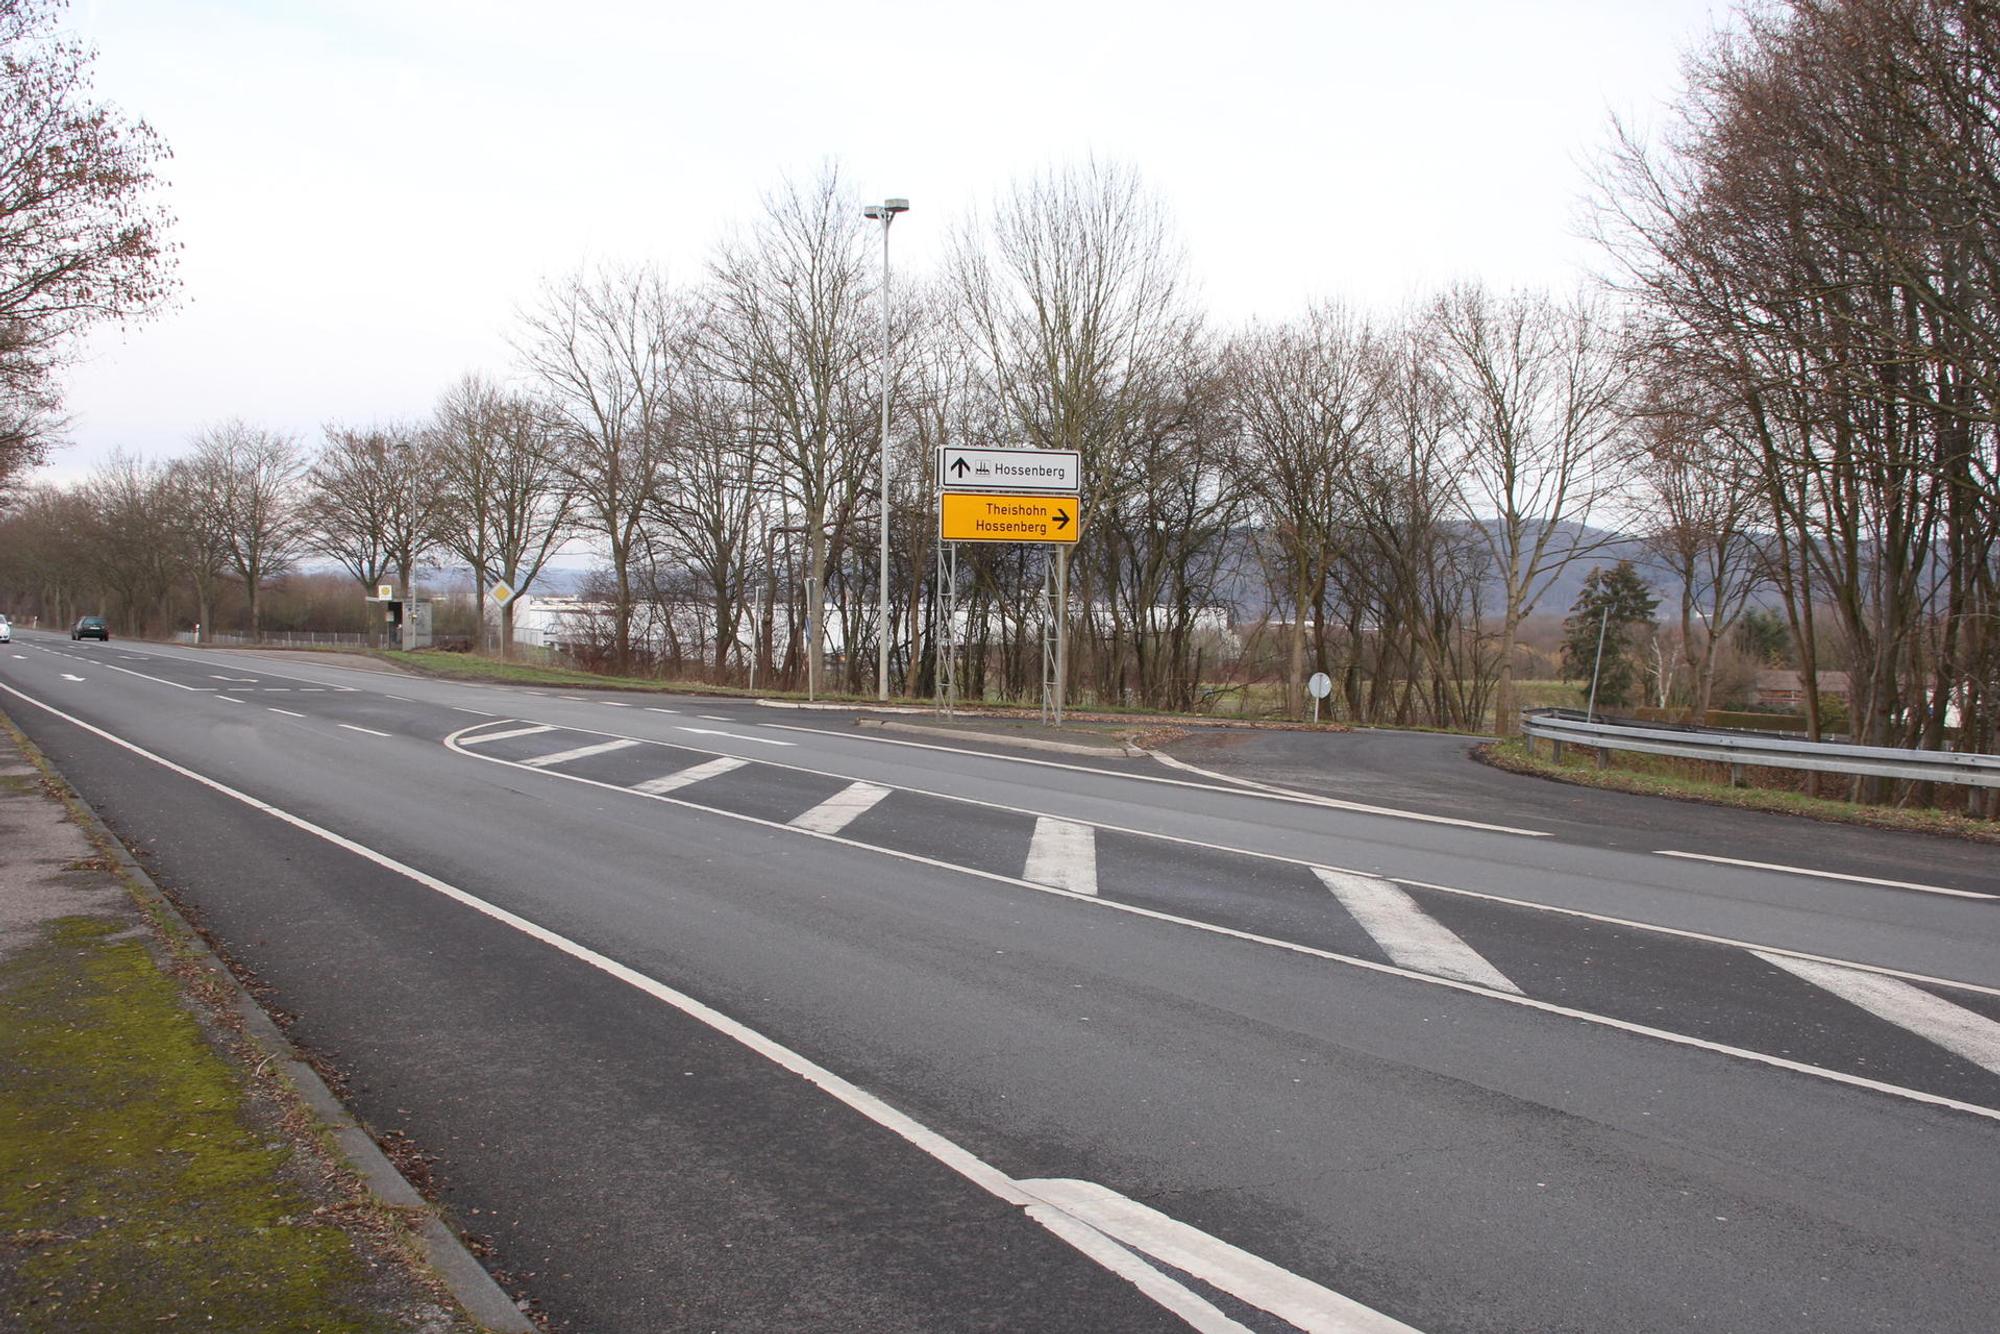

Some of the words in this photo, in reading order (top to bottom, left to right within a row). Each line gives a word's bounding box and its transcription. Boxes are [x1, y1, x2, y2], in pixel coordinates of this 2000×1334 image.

[995, 463, 1065, 480] Hossenberg
[986, 503, 1047, 516] Theishohn
[976, 520, 1047, 535] Hossenberg
